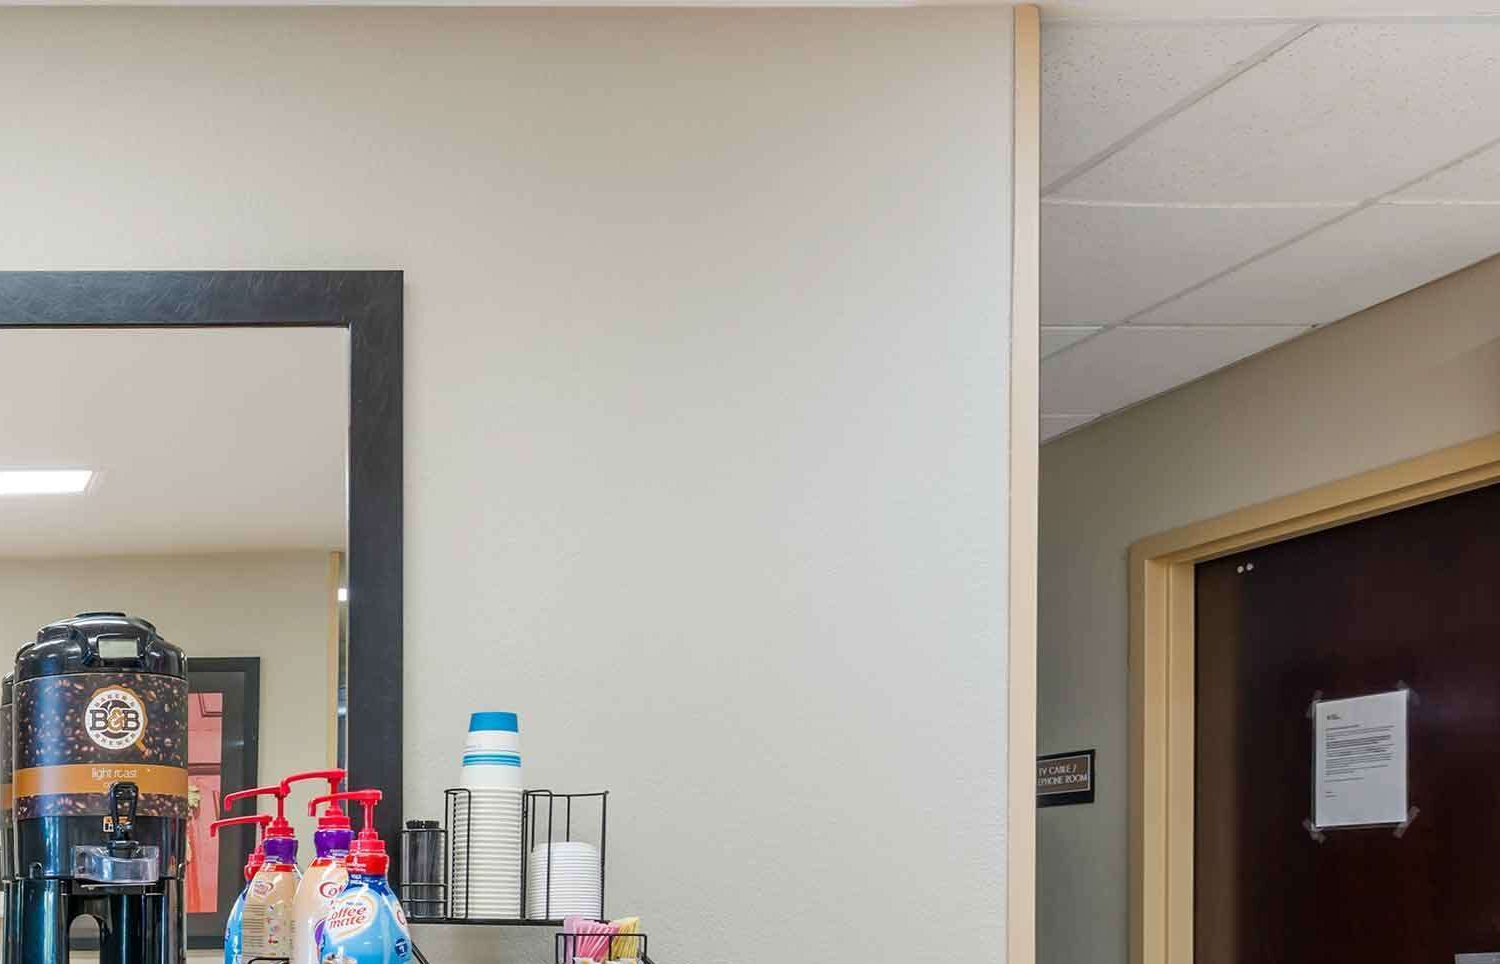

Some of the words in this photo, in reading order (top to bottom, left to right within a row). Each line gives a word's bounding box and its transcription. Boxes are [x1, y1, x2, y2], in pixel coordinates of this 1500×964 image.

[89, 707, 140, 732] B&B
[92, 768, 112, 780] light
[114, 768, 137, 778] roast
[1065, 773, 1088, 784] ROOM
[329, 914, 365, 929] mate
